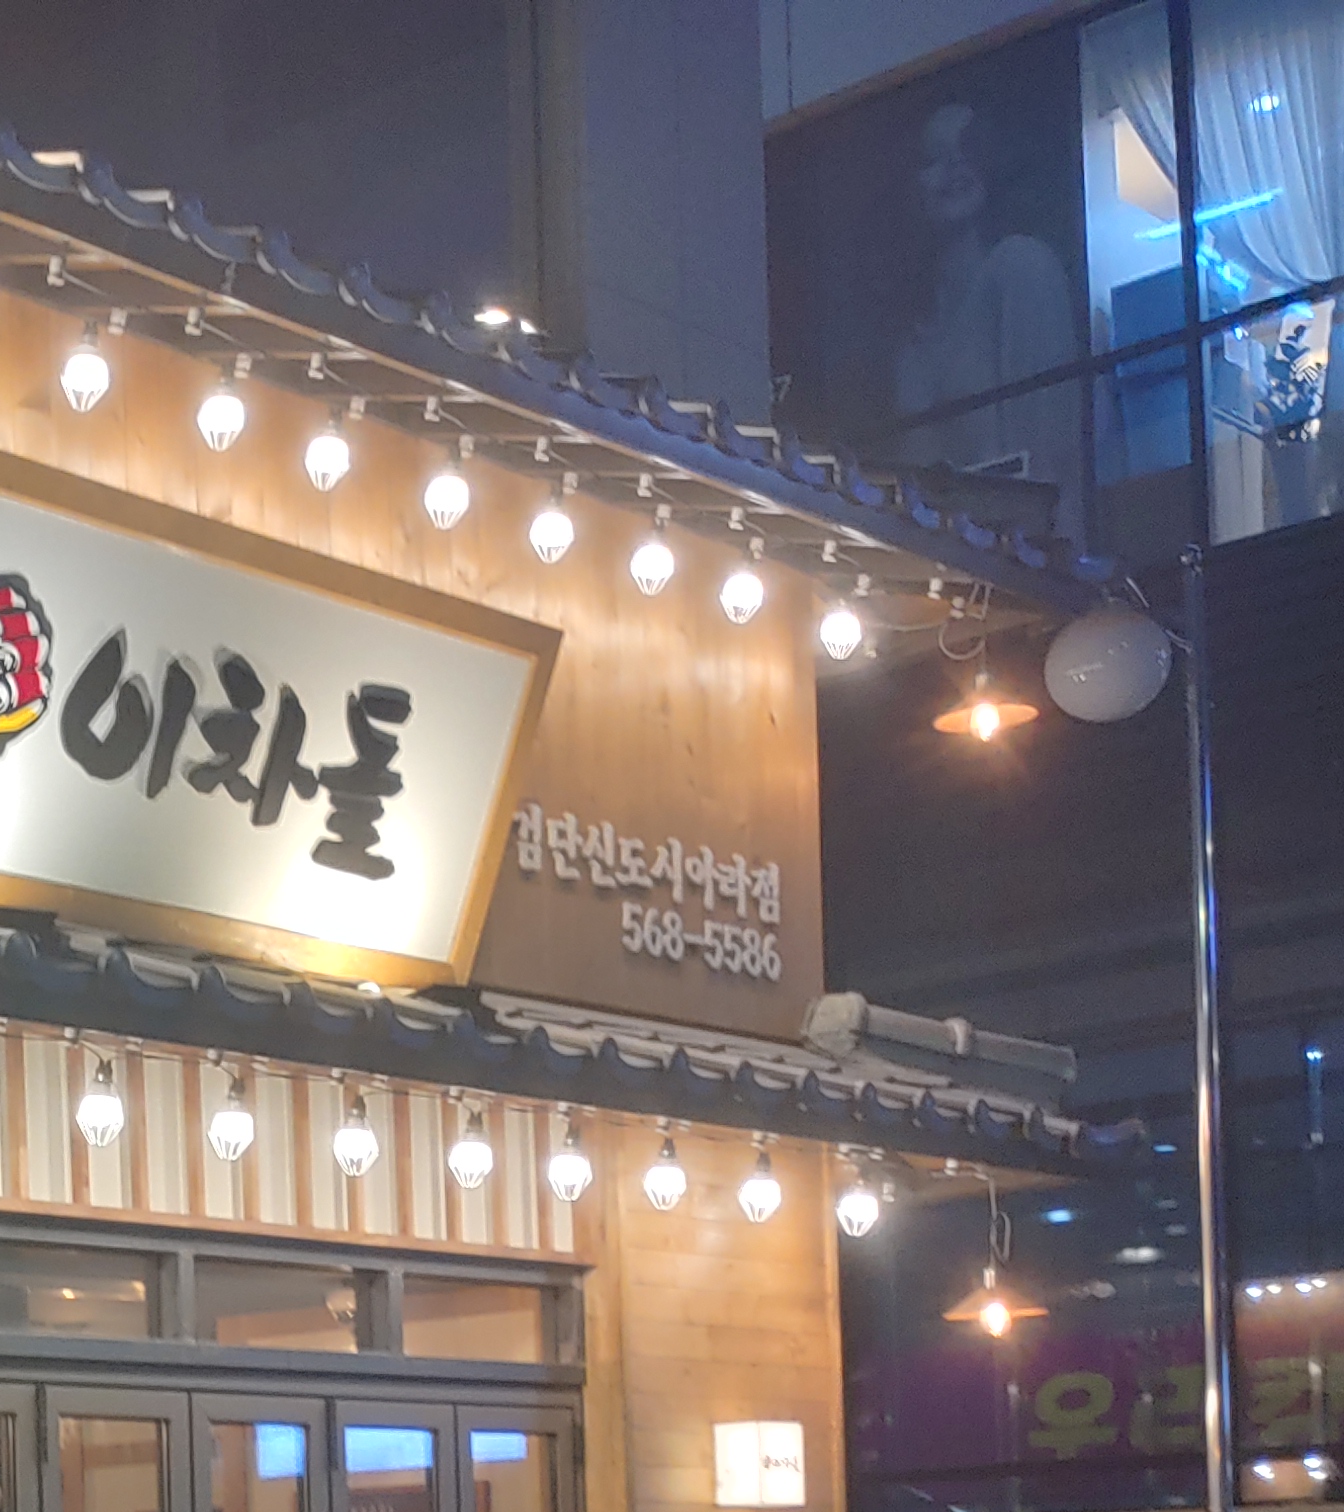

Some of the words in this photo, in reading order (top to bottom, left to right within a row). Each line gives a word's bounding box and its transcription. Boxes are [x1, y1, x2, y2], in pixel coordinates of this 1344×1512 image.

[59, 628, 411, 880] 이차돌
[514, 803, 781, 924] 검단신도시아라점
[621, 901, 781, 981] 568-5586
